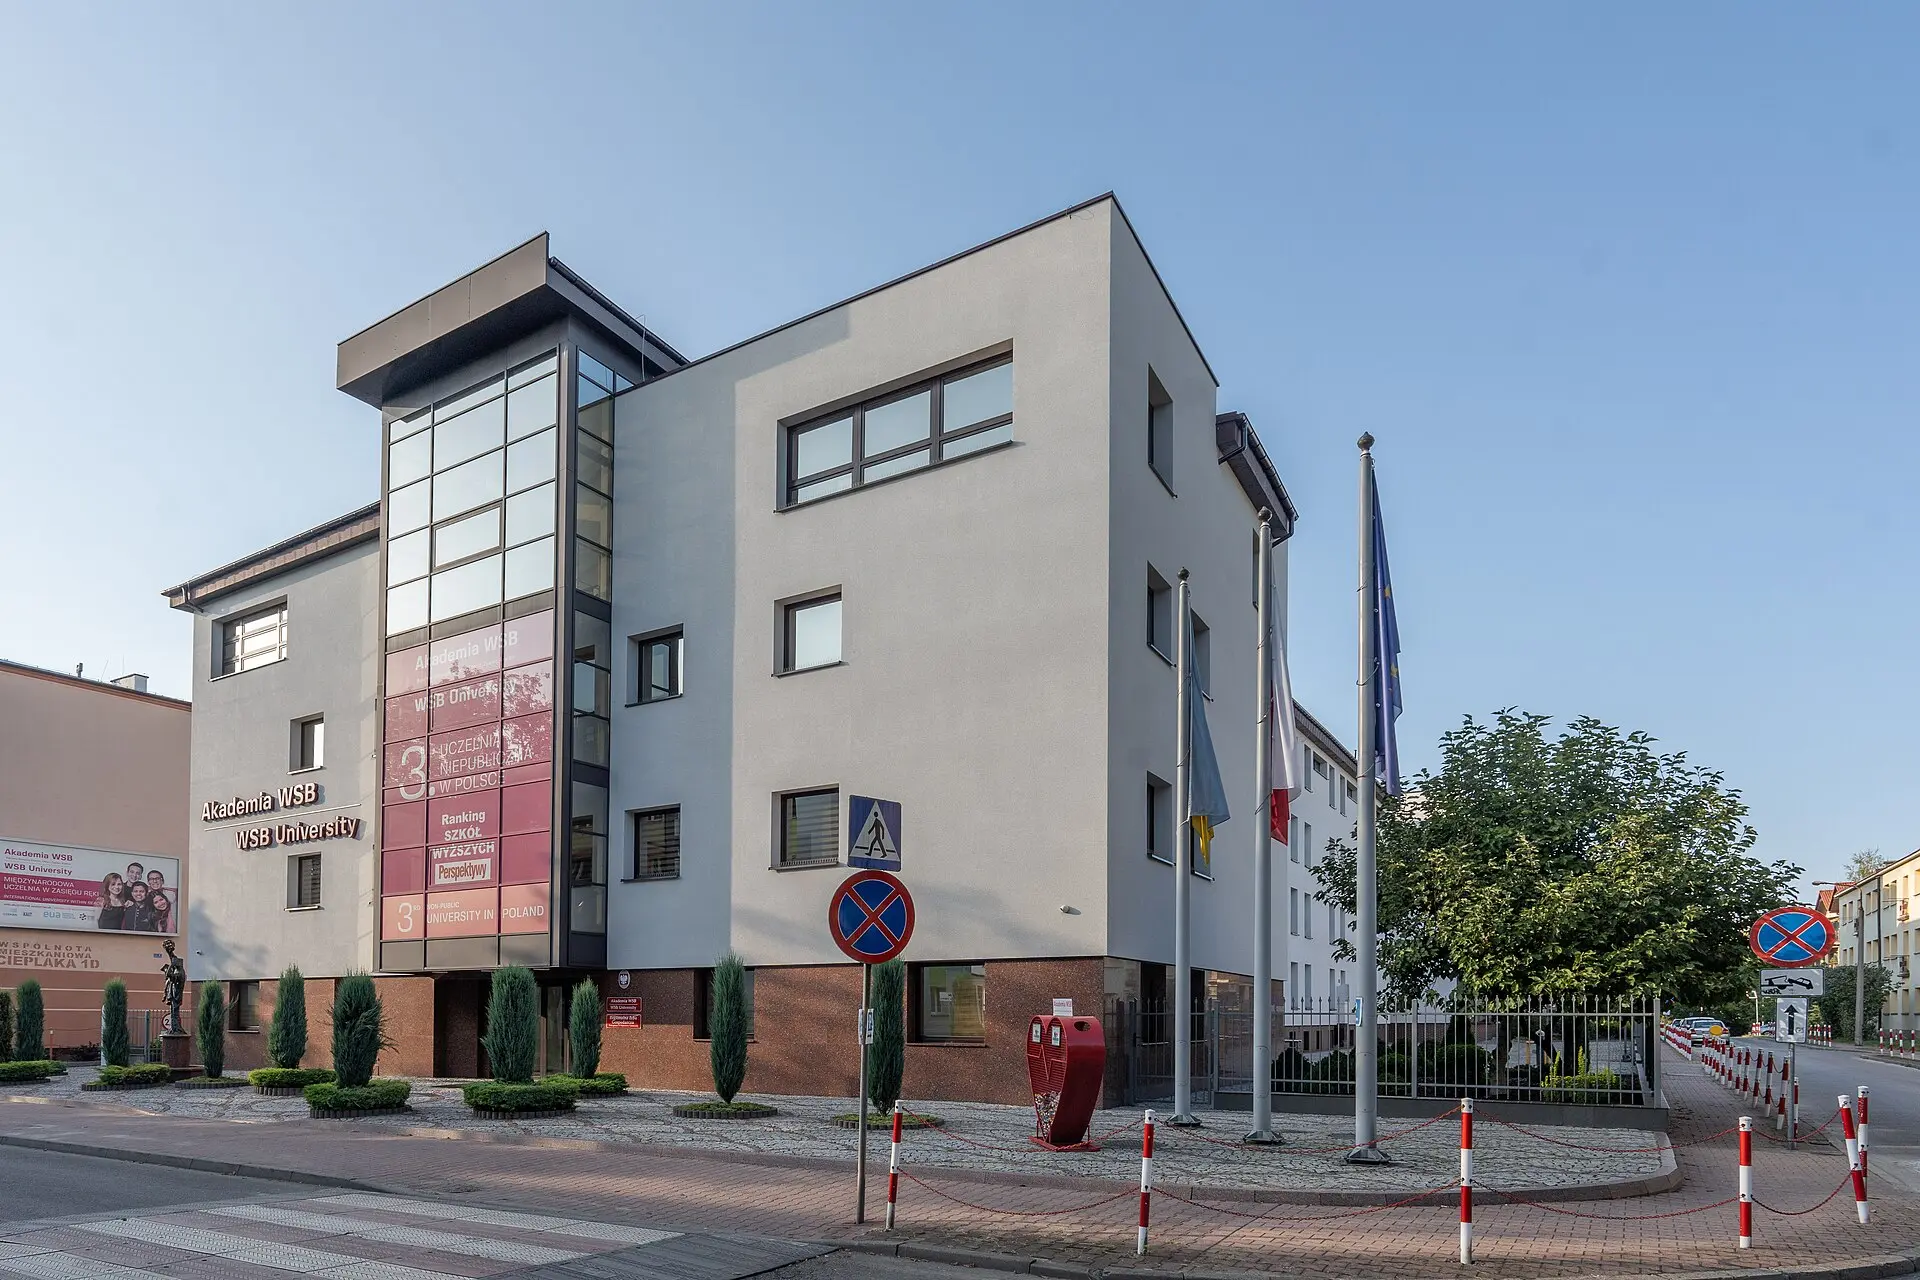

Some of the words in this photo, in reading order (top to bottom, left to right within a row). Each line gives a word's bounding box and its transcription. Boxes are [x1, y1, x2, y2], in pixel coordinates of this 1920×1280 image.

[484, 630, 518, 653] WSB
[440, 733, 500, 758] UCZELNIA
[440, 781, 451, 794] W
[455, 770, 506, 792] POLSCE
[201, 791, 273, 822] Akademia
[277, 782, 319, 809] WSB
[441, 810, 486, 826] Ranking
[235, 827, 272, 850] WSB
[275, 816, 359, 845] University
[444, 825, 482, 842] SZKÓŁ
[4, 848, 49, 859] Akademia
[51, 853, 73, 862] WSB
[432, 841, 495, 860] WYŻSZYCH
[4, 862, 26, 871] WSB
[29, 864, 73, 877] University
[438, 862, 487, 881] Perspektywy
[3, 876, 75, 888] MIĘDZYNARODOWA
[3, 884, 41, 892] UCZELNIA
[51, 887, 82, 897] ZASIĘGU
[426, 910, 481, 925] UNIVERSITY
[483, 908, 494, 920] IN
[502, 905, 545, 919] POLAND
[0, 949, 92, 959] MIESZKANIOWA
[0, 955, 77, 969] CIEPLAKA
[81, 959, 100, 969] 1D
